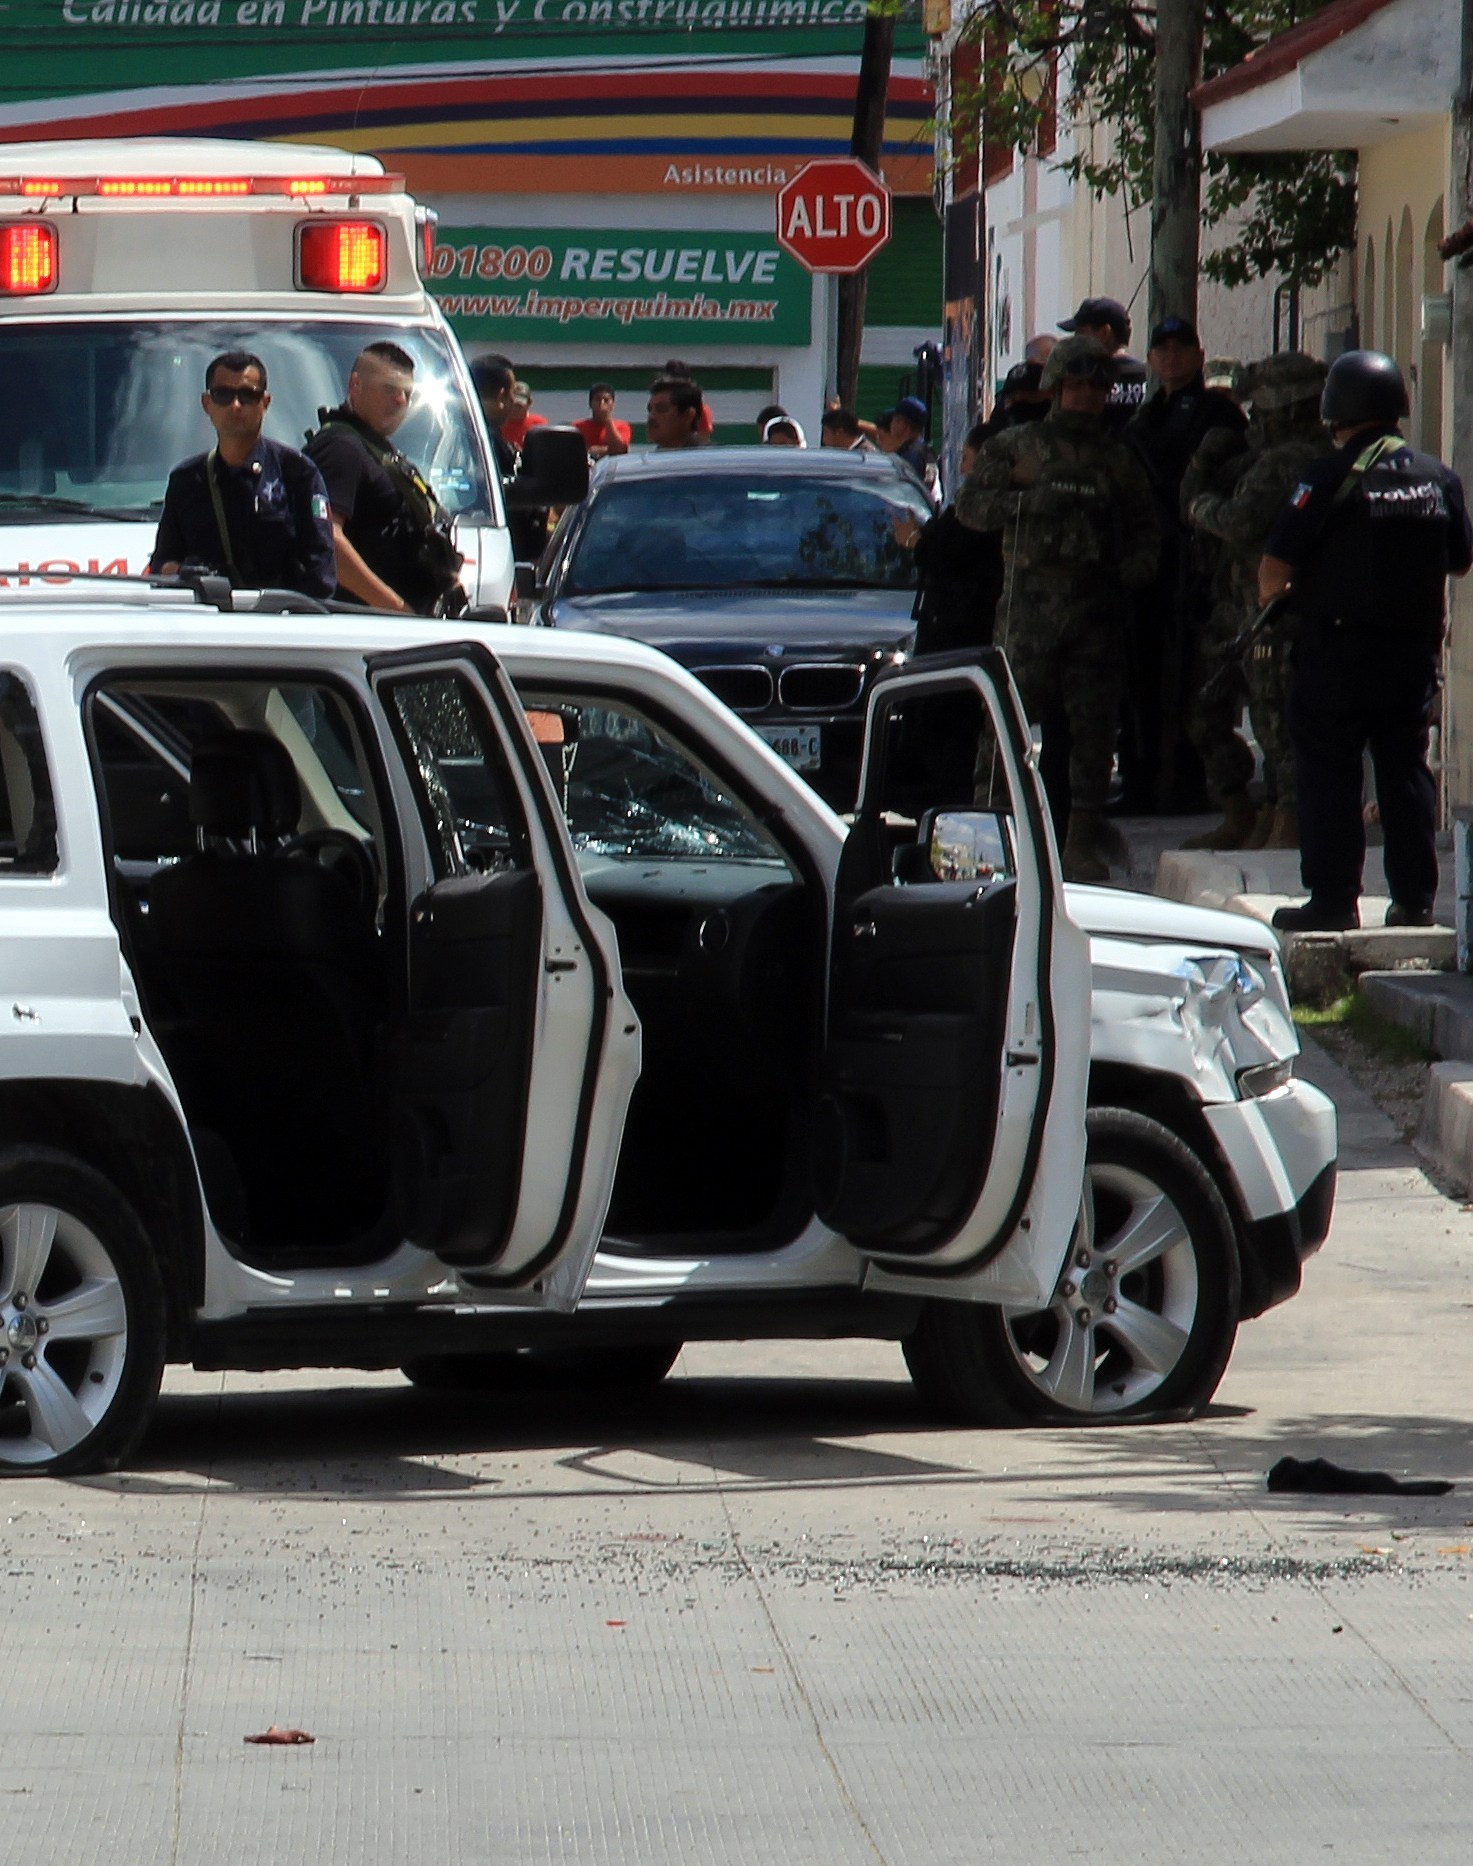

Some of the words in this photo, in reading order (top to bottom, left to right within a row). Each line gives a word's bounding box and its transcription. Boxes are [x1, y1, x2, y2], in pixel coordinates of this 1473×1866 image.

[235, 0, 284, 25] en
[494, 0, 521, 33] y
[663, 163, 787, 185] Asistencia
[786, 193, 882, 239] ALTO
[430, 245, 553, 281] 01800
[559, 247, 780, 285] RESUELVE
[435, 288, 779, 325] www.imperquimia.mx
